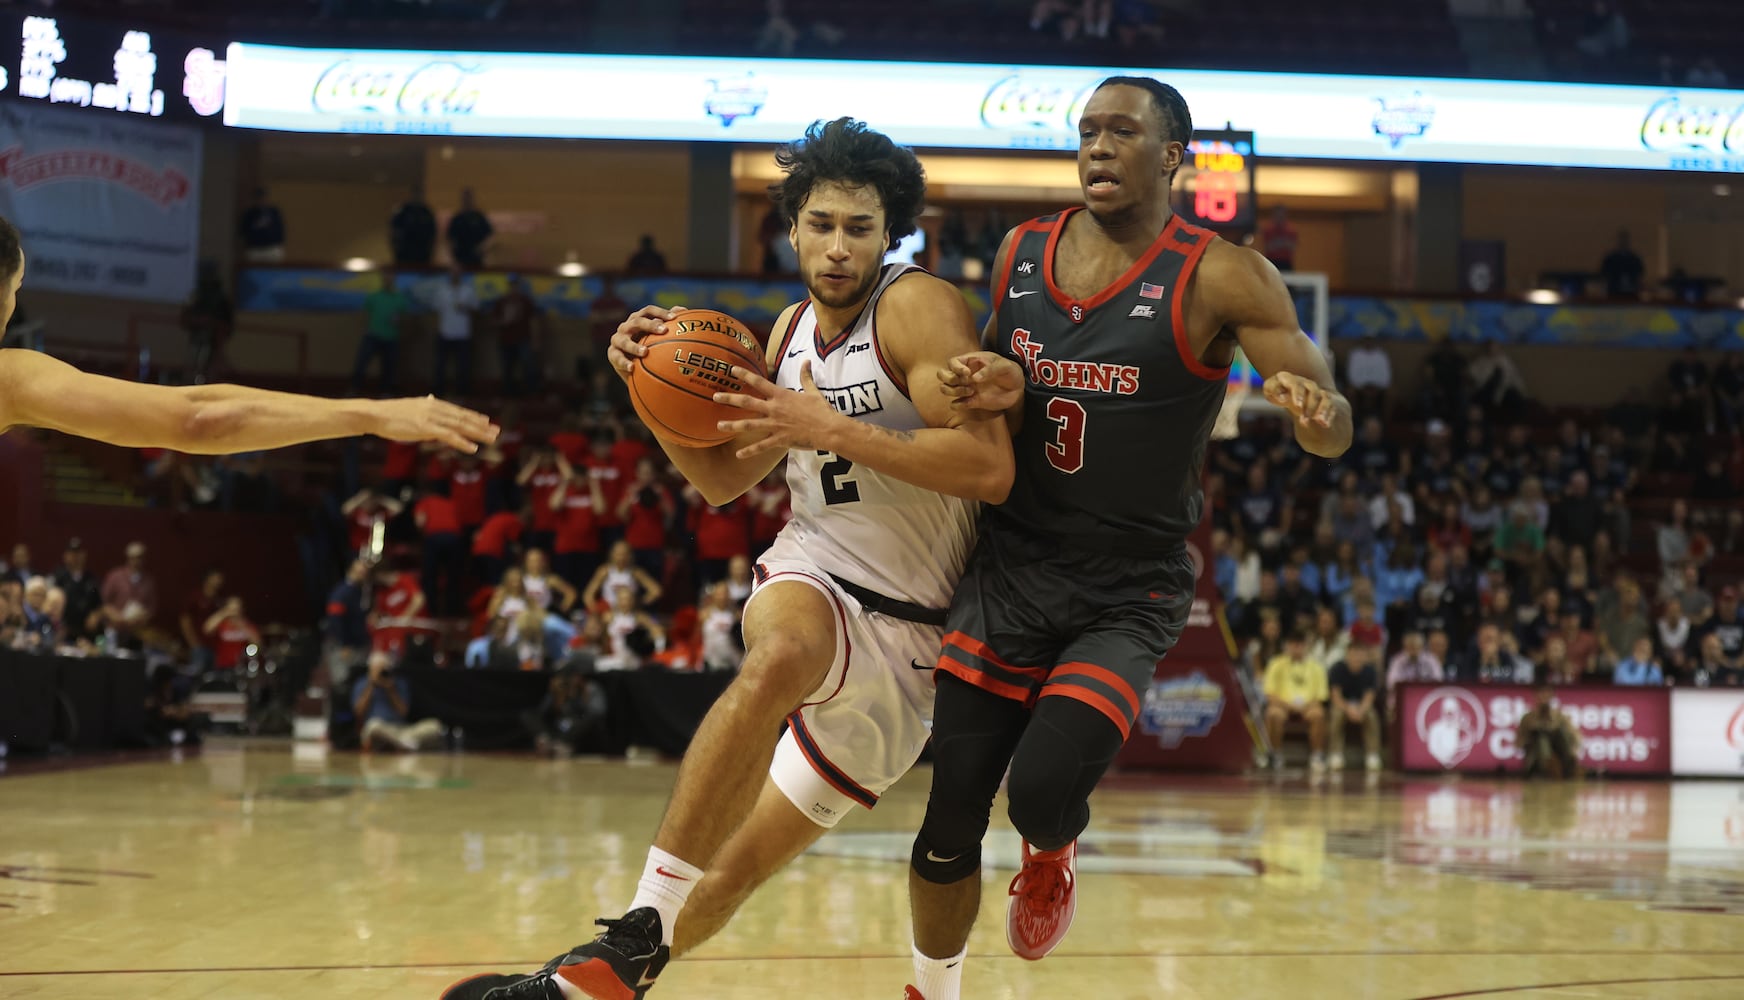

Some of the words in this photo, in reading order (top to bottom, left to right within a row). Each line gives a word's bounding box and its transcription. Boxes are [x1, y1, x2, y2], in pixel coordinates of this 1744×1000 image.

[673, 348, 739, 381] LEGAC
[1045, 396, 1087, 475] 3
[816, 449, 861, 506] 2
